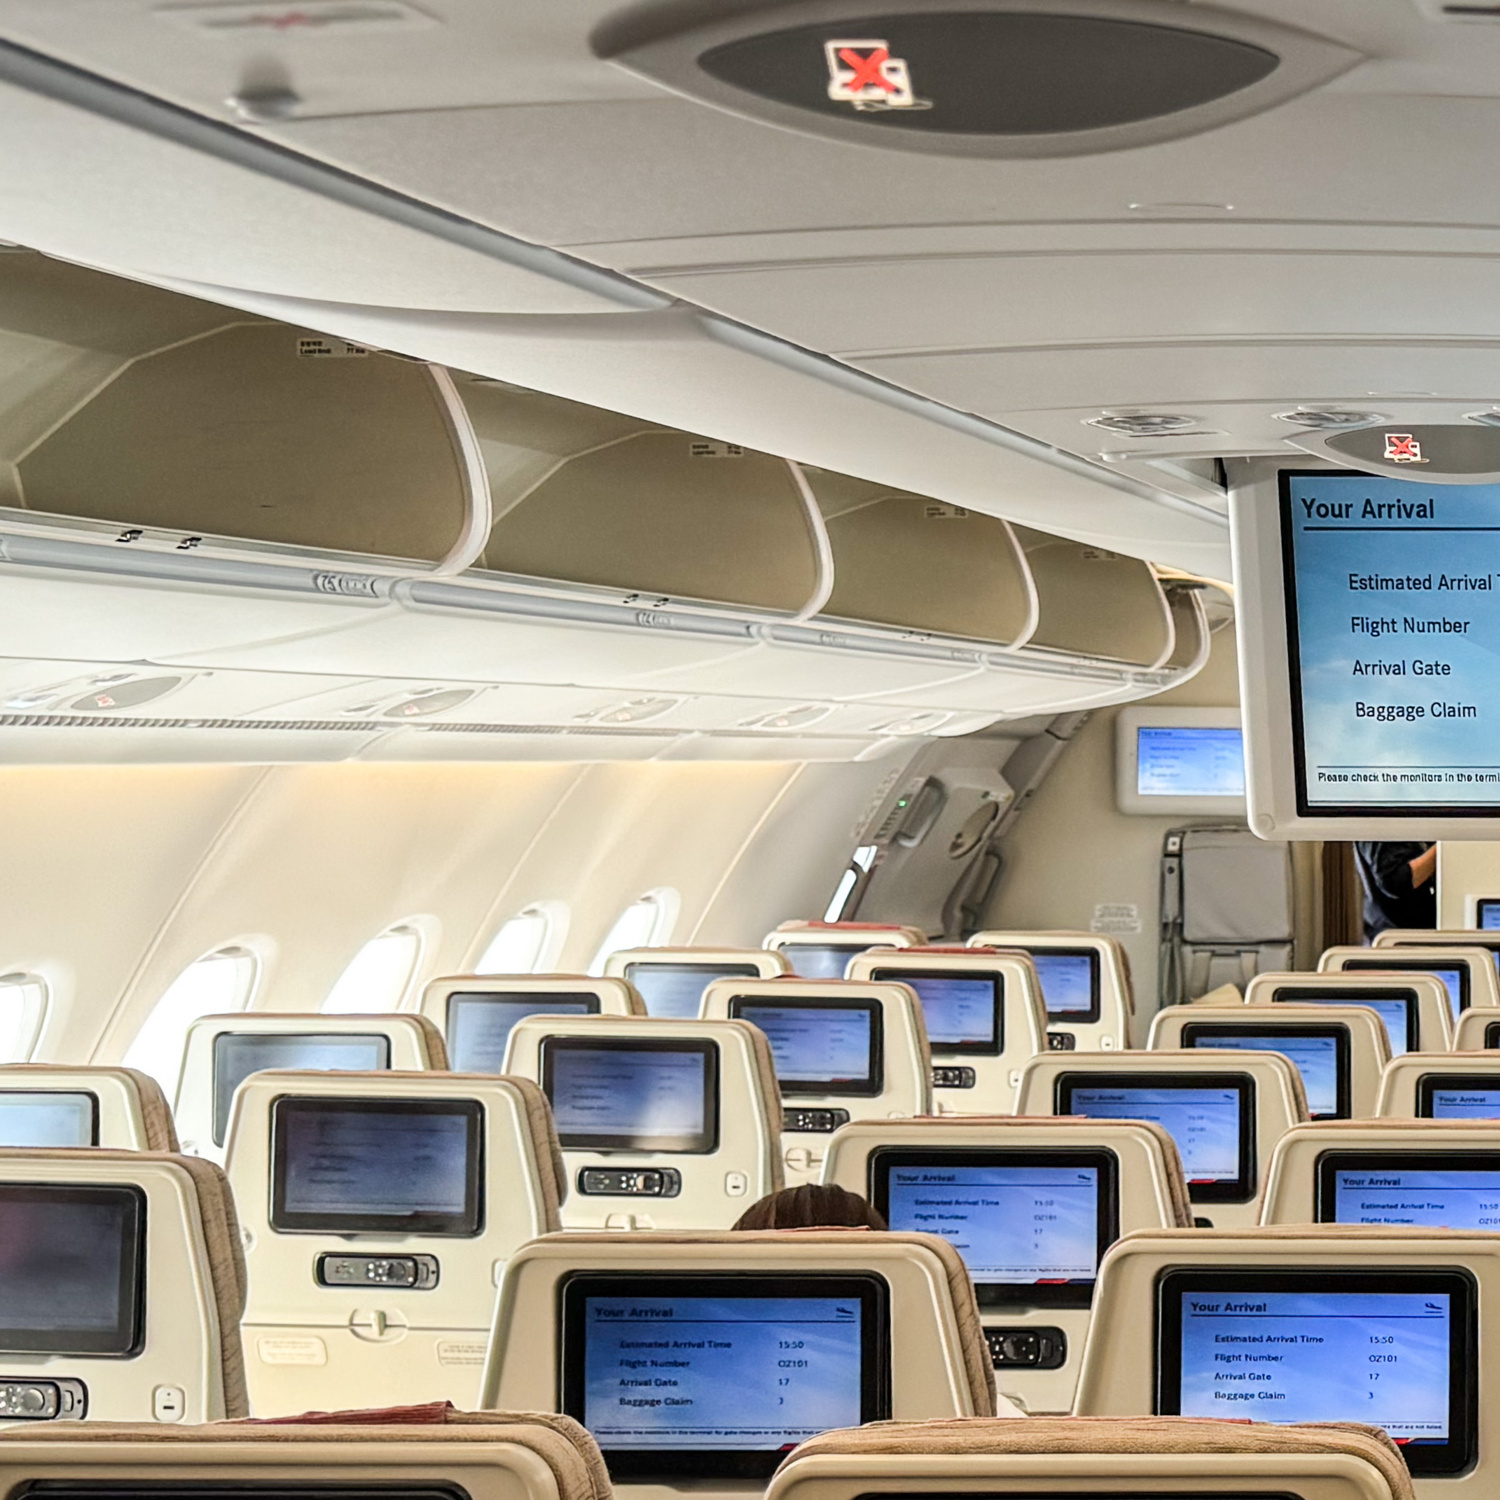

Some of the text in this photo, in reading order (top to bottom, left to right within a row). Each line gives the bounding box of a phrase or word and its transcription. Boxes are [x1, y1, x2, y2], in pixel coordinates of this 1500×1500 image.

[1300, 497, 1434, 519] Your Arrival
[1348, 573, 1432, 590] Estimated
[1437, 573, 1492, 590] Arrival
[1351, 616, 1398, 637] Flight
[1403, 616, 1470, 633] Number
[1352, 659, 1406, 675] Arrival
[1412, 659, 1451, 675] Gate
[1355, 701, 1425, 722] Baggage
[1430, 701, 1476, 718] Claim
[1317, 772, 1348, 782] Please
[1350, 772, 1379, 782] check
[1381, 772, 1398, 782] the
[1400, 772, 1442, 782] monitors
[1444, 772, 1454, 782] in
[1456, 773, 1472, 782] the
[1190, 1301, 1266, 1312] Your Arrival
